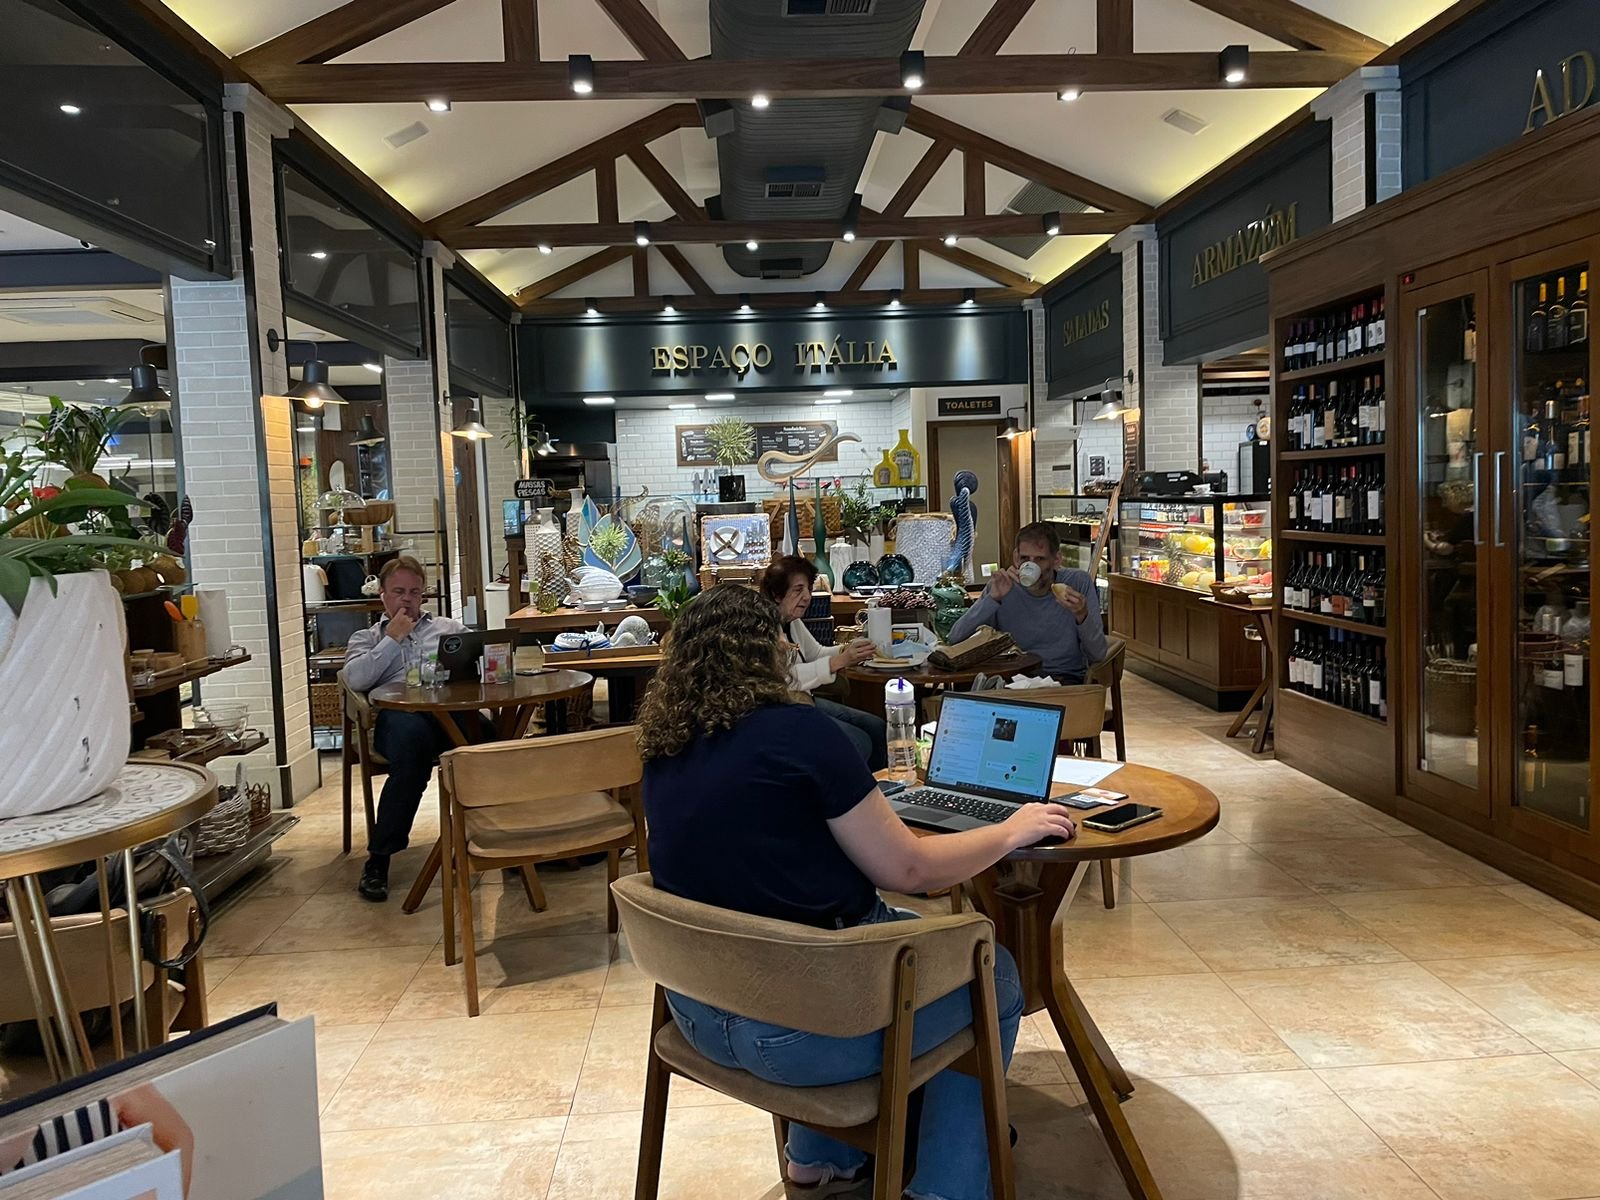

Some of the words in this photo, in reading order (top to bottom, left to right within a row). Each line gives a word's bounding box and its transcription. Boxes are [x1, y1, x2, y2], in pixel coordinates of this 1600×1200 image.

[1191, 201, 1298, 289] ARMAZÉM
[652, 343, 772, 373] ESPAÇO
[795, 334, 897, 366] ITÁLIA
[945, 400, 993, 409] TOALETES
[518, 480, 546, 488] MASSAS
